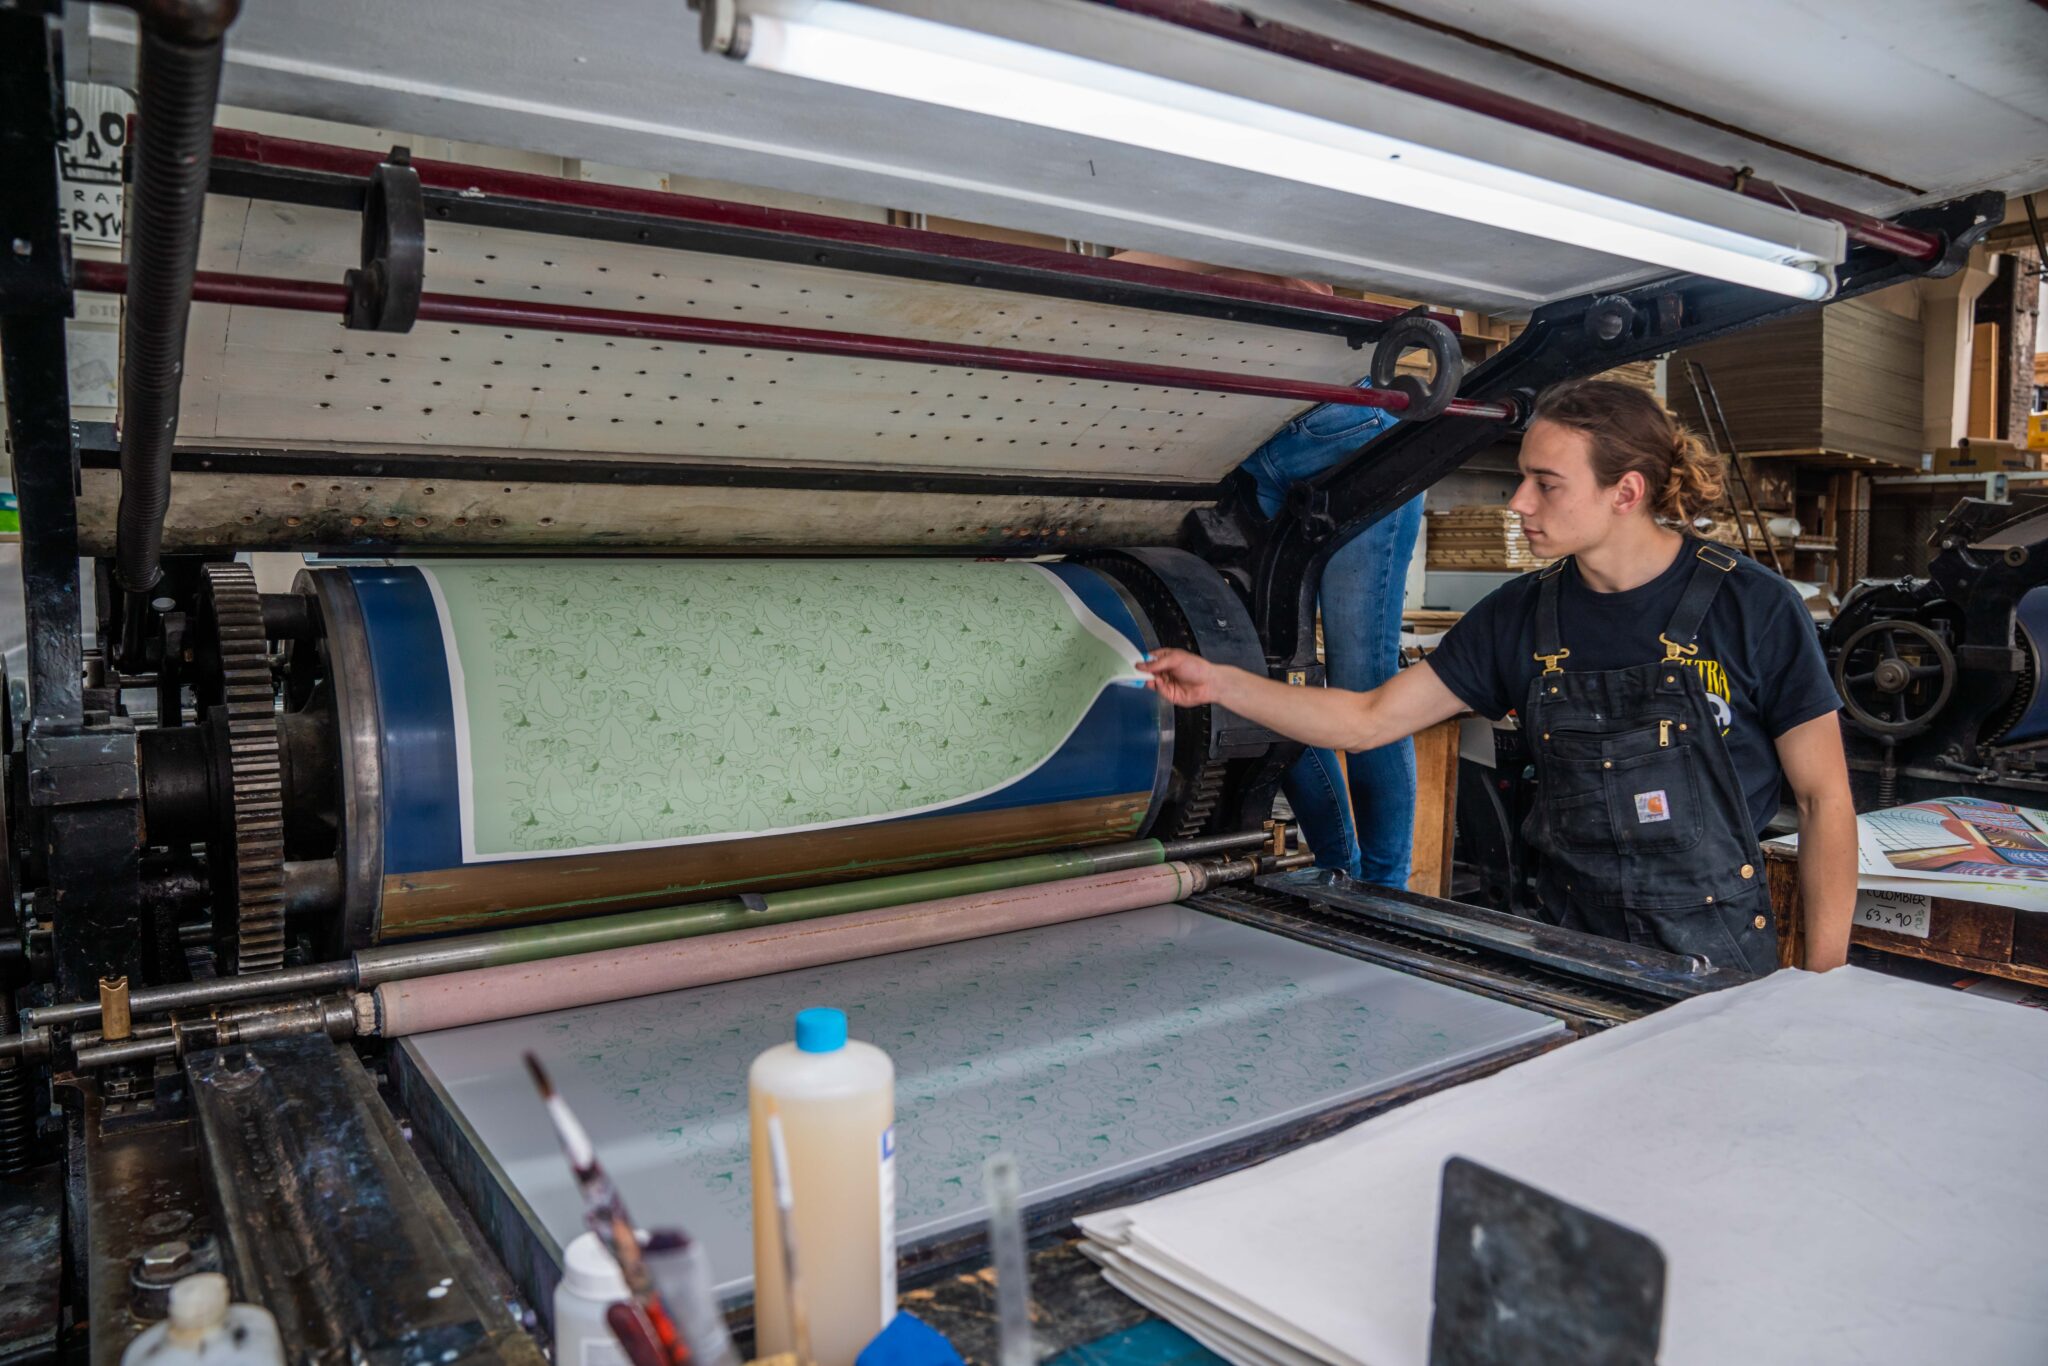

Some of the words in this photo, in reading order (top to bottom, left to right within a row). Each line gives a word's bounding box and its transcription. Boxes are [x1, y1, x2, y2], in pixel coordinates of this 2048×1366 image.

[1686, 659, 1731, 705] TRA
[1866, 908, 1881, 922] 63
[1895, 912, 1912, 927] 90
